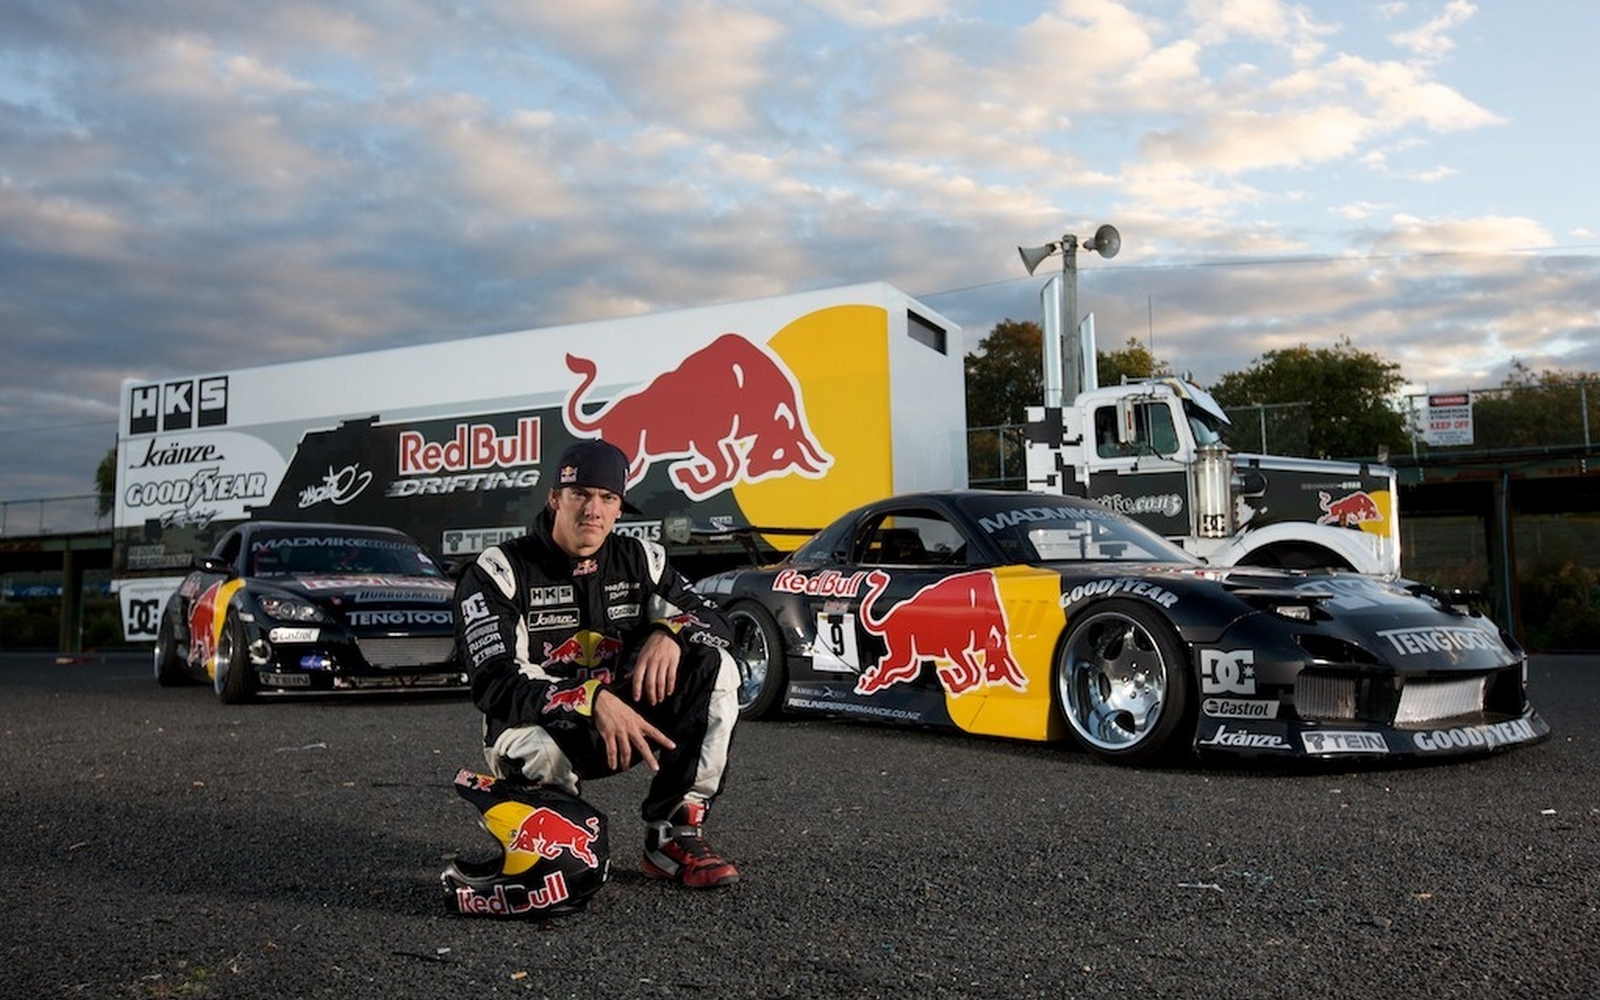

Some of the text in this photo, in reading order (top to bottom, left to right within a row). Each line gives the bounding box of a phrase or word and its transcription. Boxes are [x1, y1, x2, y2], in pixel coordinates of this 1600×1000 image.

[131, 377, 227, 430] HKS
[1430, 421, 1469, 430] KEEP OFF
[128, 438, 225, 469] kränze
[399, 416, 541, 475] Red Bull
[125, 470, 267, 510] GOODYEAR
[385, 469, 541, 497] DRIFTING
[530, 585, 574, 606] HKS
[772, 569, 868, 597] Red Bull
[1060, 577, 1179, 609] GOODYEAR
[128, 599, 159, 635] DC
[830, 623, 845, 656] 9
[1201, 650, 1256, 694] DC
[787, 698, 921, 719] REDLINEPERFORMANCE.CO.NZ
[1220, 701, 1268, 716] Castrol
[1199, 724, 1292, 750] kränze
[1326, 733, 1386, 750] TEIN
[1413, 718, 1538, 752] GOODYEAR
[456, 884, 509, 915] Red
